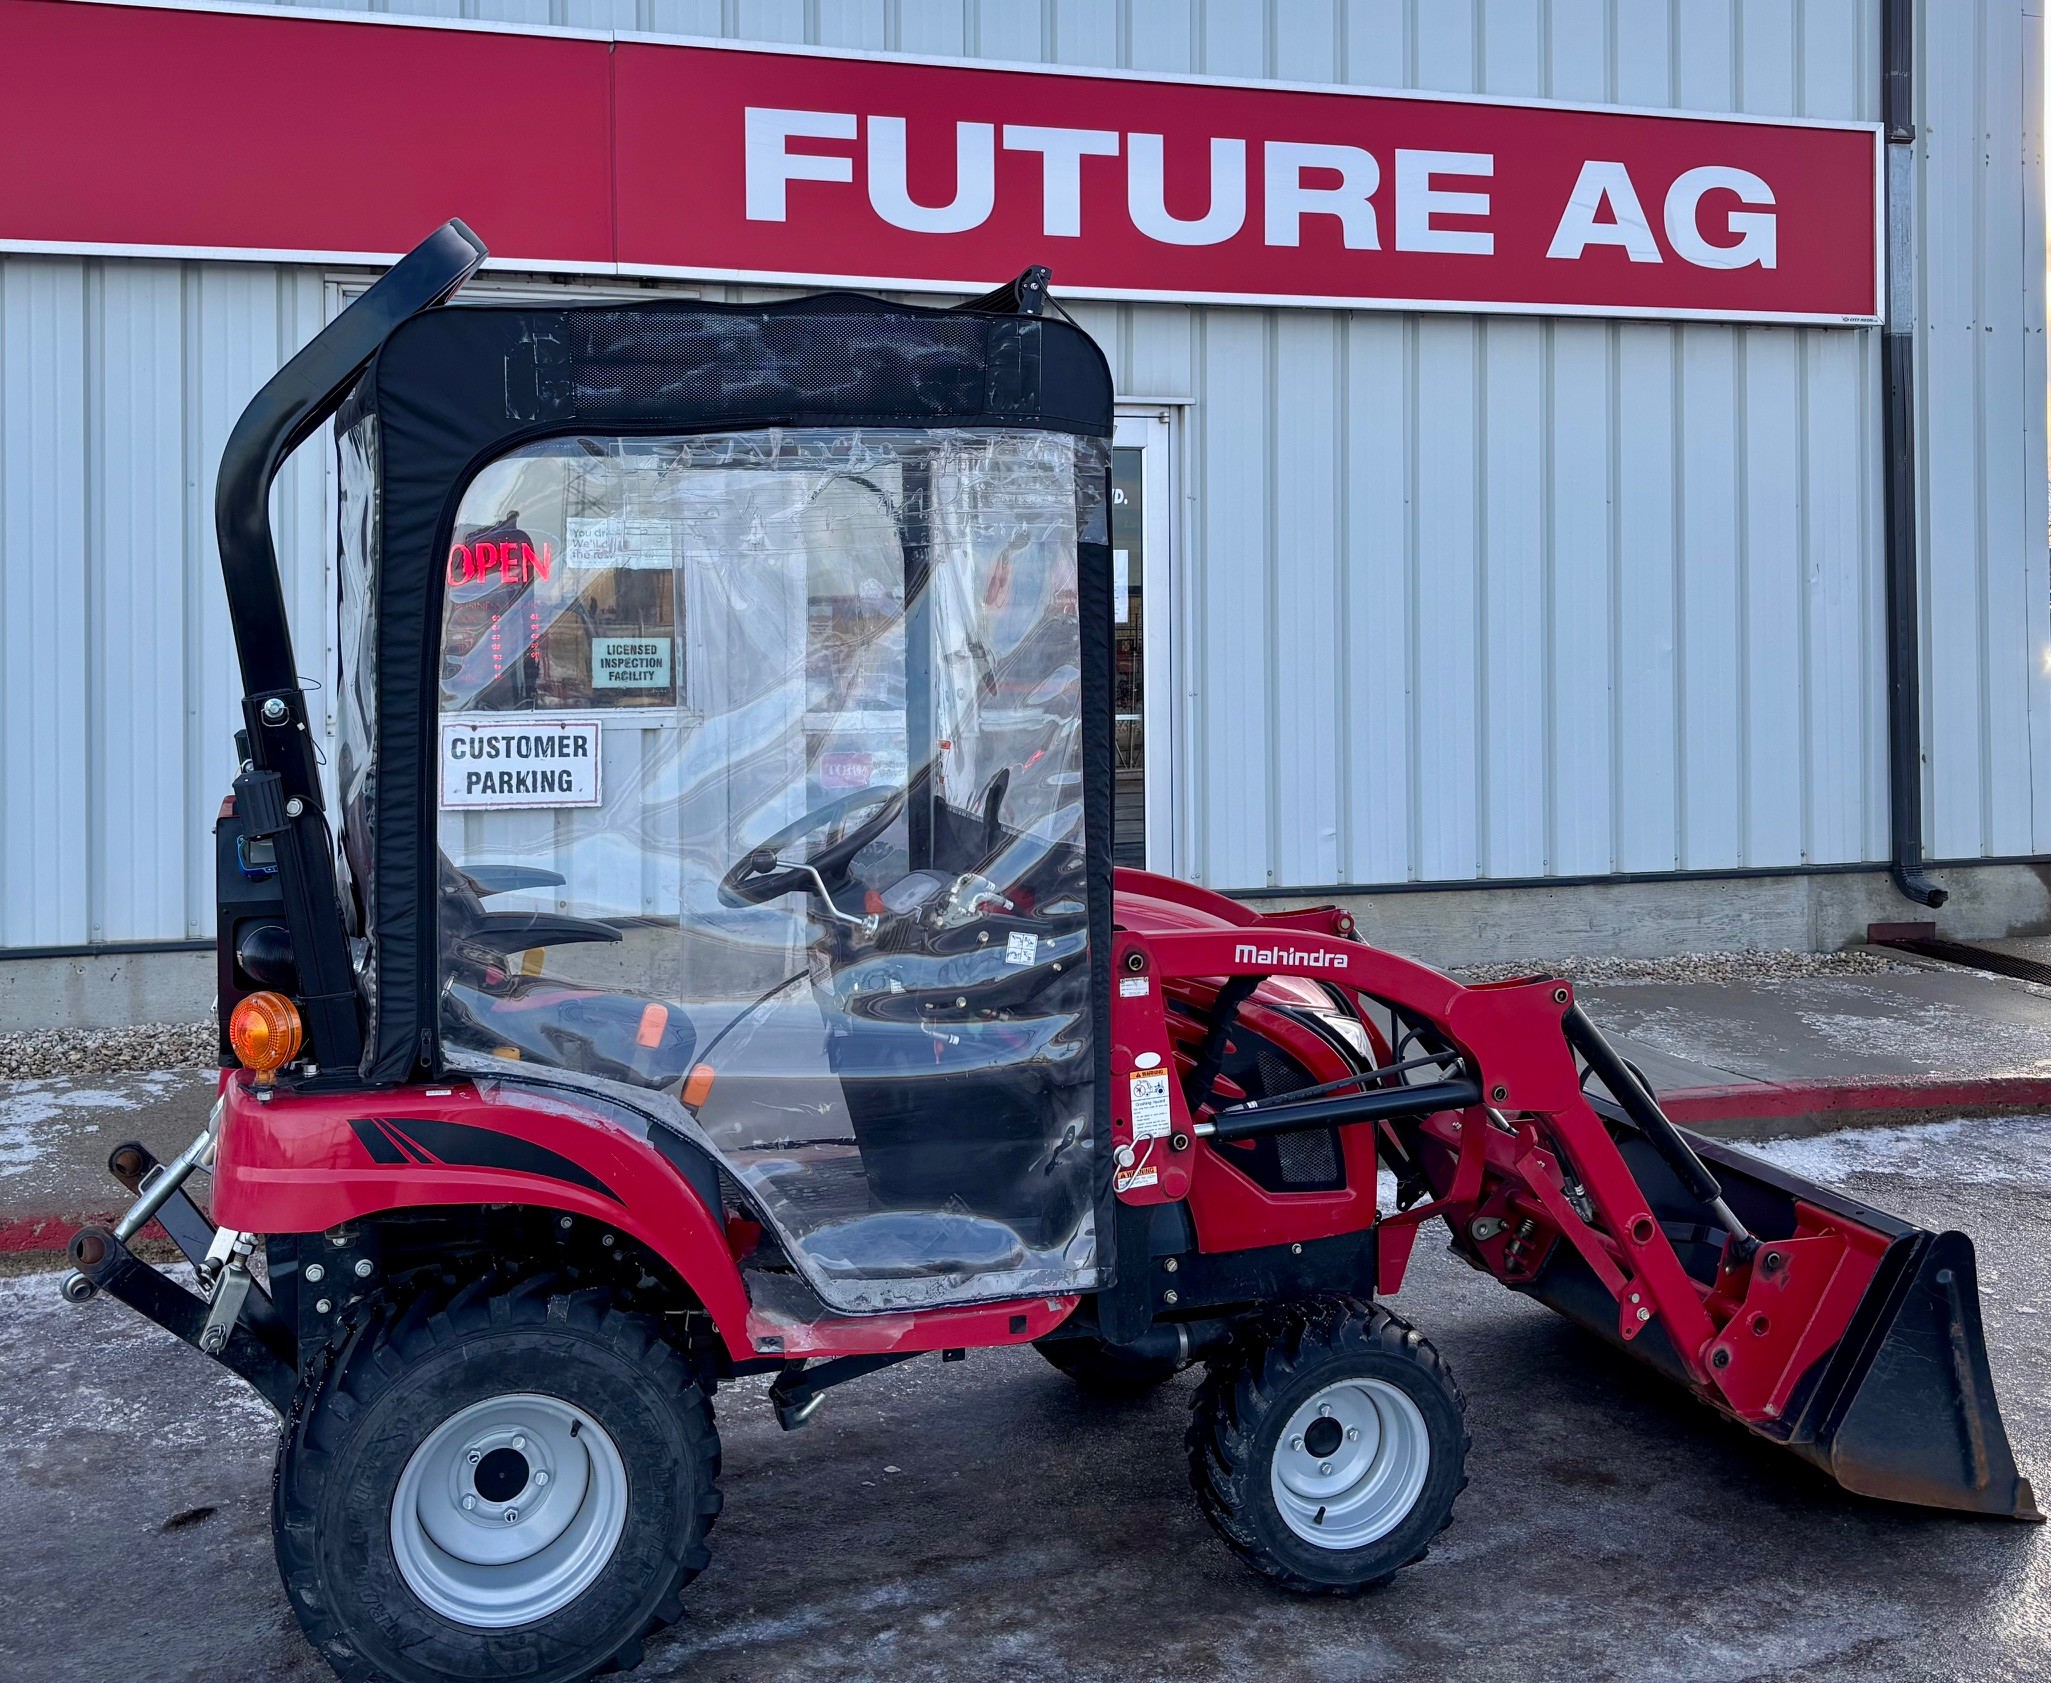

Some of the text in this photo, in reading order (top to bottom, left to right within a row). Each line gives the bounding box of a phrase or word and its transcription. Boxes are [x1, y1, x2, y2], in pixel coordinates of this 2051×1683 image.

[745, 107, 1777, 269] FUTURE AG
[572, 529, 591, 538] You
[447, 542, 551, 587] OPEN
[607, 644, 657, 655] LICENSED
[600, 657, 663, 668] INSPECTION
[608, 671, 655, 681] FACILITY
[451, 735, 588, 759] CUSTOMER
[466, 769, 572, 795] PARKING
[1235, 944, 1348, 968] Mahindra
